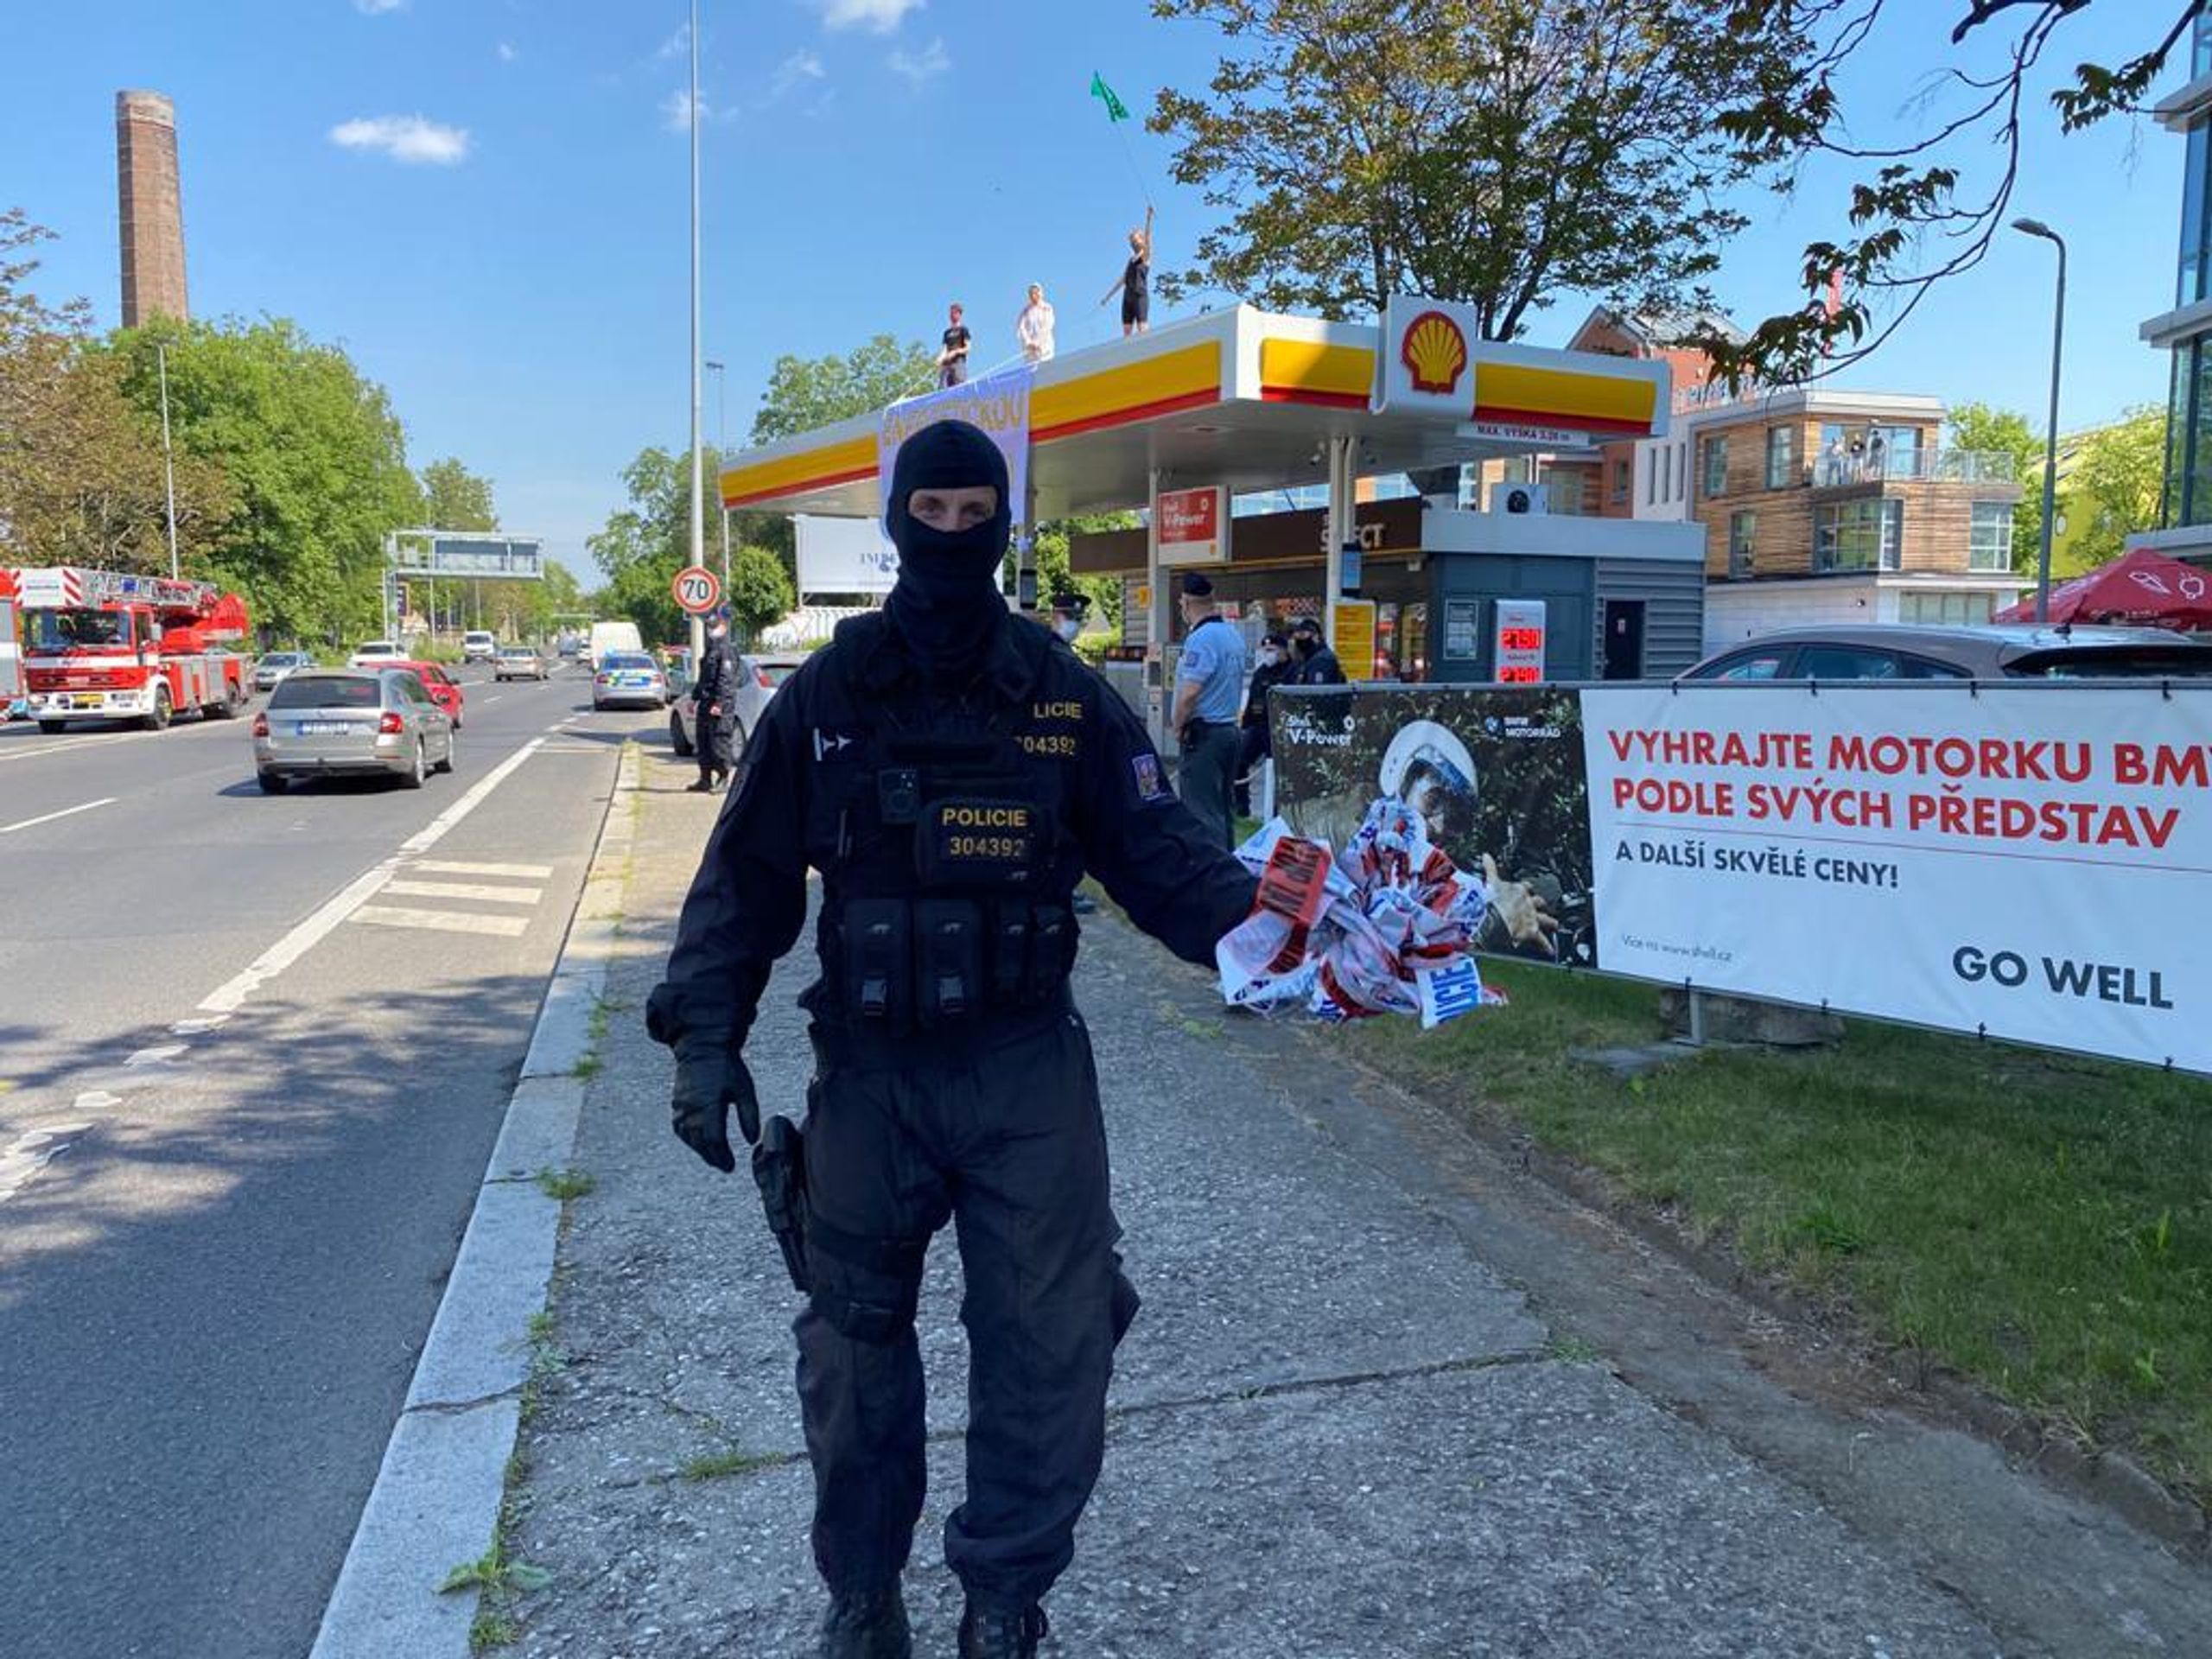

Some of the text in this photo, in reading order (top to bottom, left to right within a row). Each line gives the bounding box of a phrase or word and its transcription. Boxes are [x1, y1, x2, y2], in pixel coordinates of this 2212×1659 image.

[683, 578, 709, 600] 70
[1014, 735, 1075, 756] 04392
[1608, 730, 2212, 789] VYHRAJTE MOTORKU BM
[942, 808, 1028, 827] POLICIE
[1613, 777, 2180, 848] PODLE SVÝCH PŘEDSTAV
[950, 836, 1026, 857] 304392
[1615, 840, 1898, 888] A DALŠÍ SKVĚLÉ CENY!
[1953, 946, 2173, 1009] GO WELL
